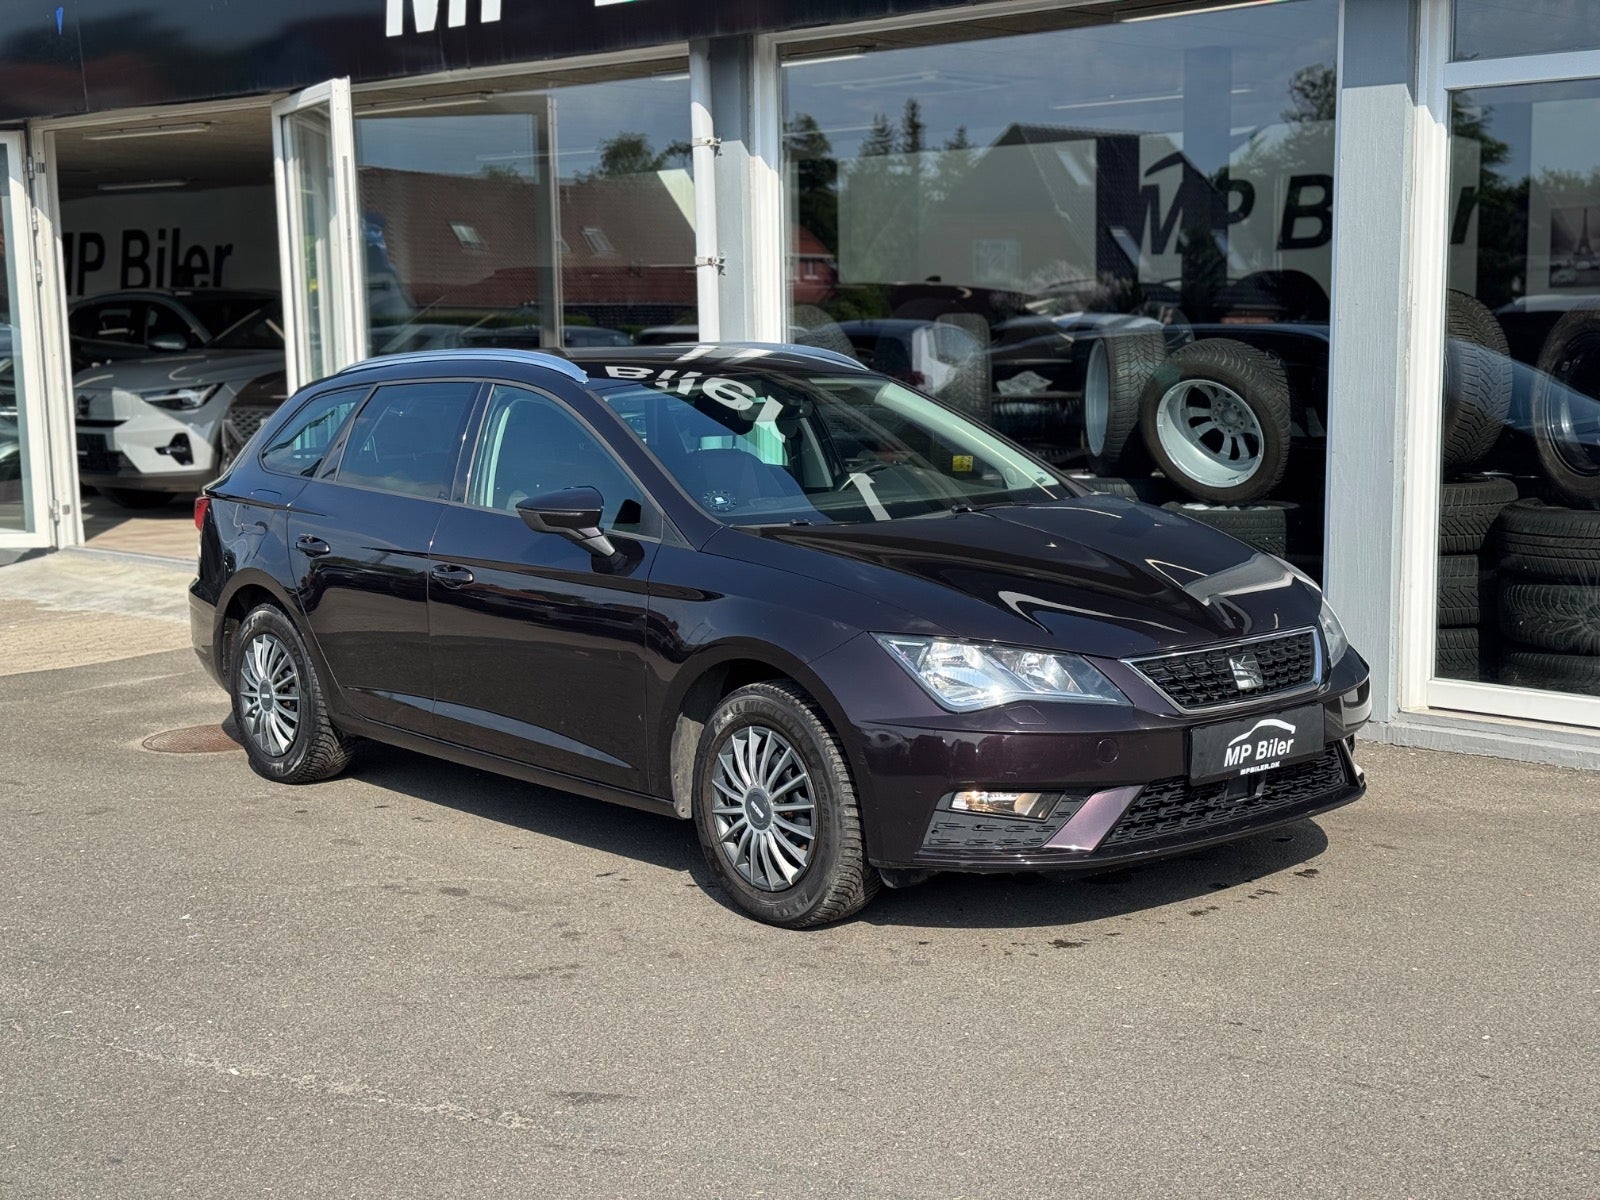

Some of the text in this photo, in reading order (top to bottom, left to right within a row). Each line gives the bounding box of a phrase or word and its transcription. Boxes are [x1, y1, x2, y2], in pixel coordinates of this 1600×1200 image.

[121, 228, 233, 289] Biler
[1224, 738, 1294, 767] MP Biler
[1240, 761, 1280, 775] MPBILER.DK
